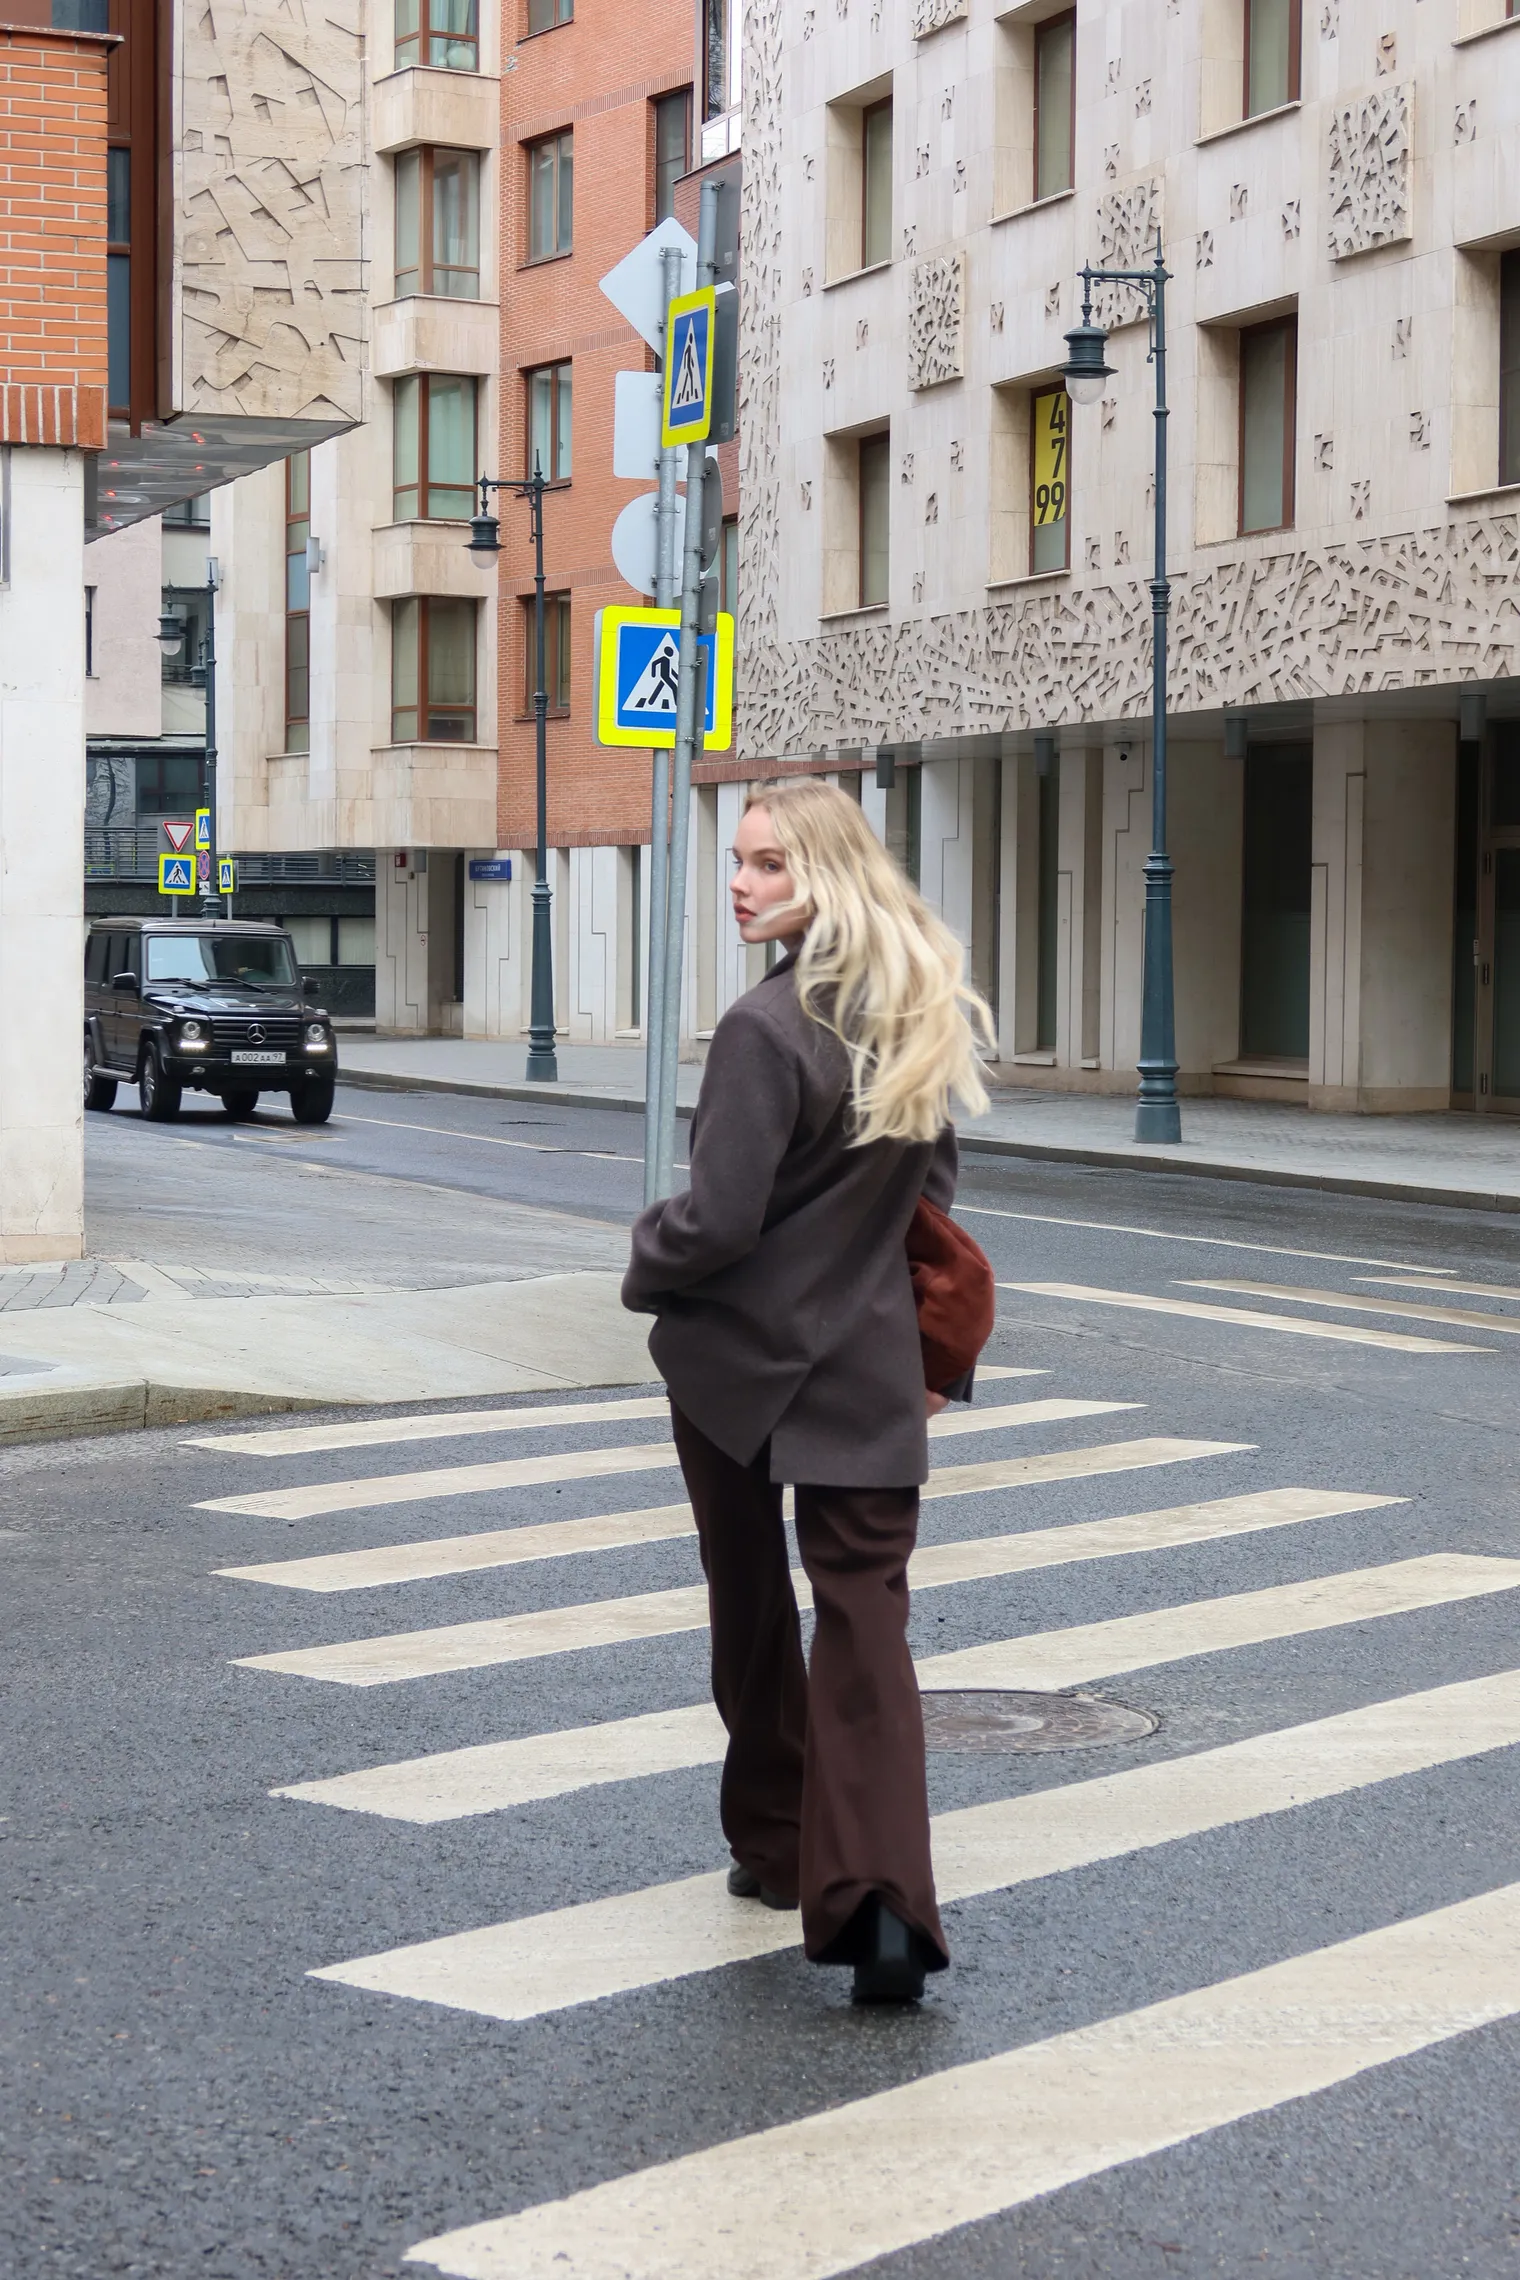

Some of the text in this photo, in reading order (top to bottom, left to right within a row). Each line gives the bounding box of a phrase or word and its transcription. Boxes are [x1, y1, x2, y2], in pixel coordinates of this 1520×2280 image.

[1049, 393, 1066, 434] 4
[1051, 436, 1065, 479] 7
[1036, 481, 1065, 525] 99
